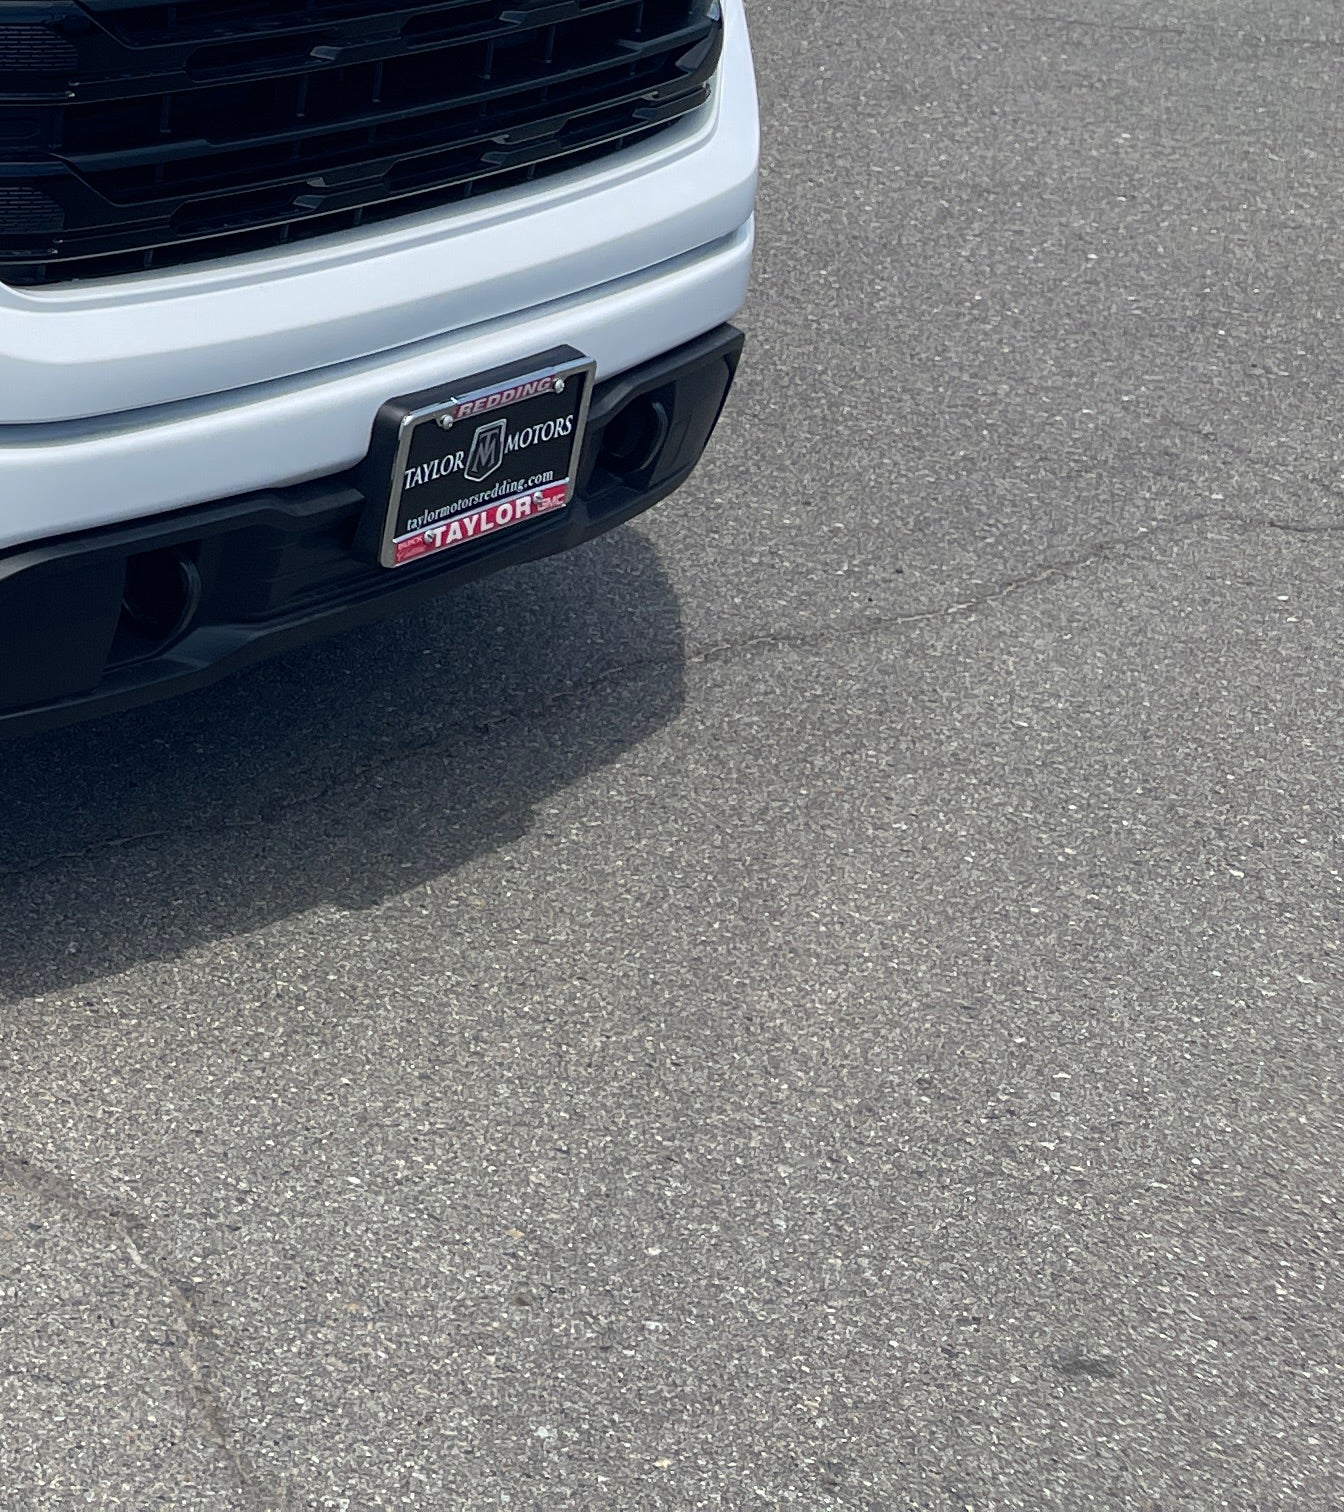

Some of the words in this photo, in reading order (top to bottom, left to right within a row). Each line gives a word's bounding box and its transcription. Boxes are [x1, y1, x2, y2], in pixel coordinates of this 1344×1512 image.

[457, 376, 553, 418] REDDING
[404, 450, 465, 490] TAYLOR
[504, 414, 574, 455] MOTORS
[406, 470, 554, 532] taylormotorsredding.com
[432, 496, 532, 548] TAYLOR
